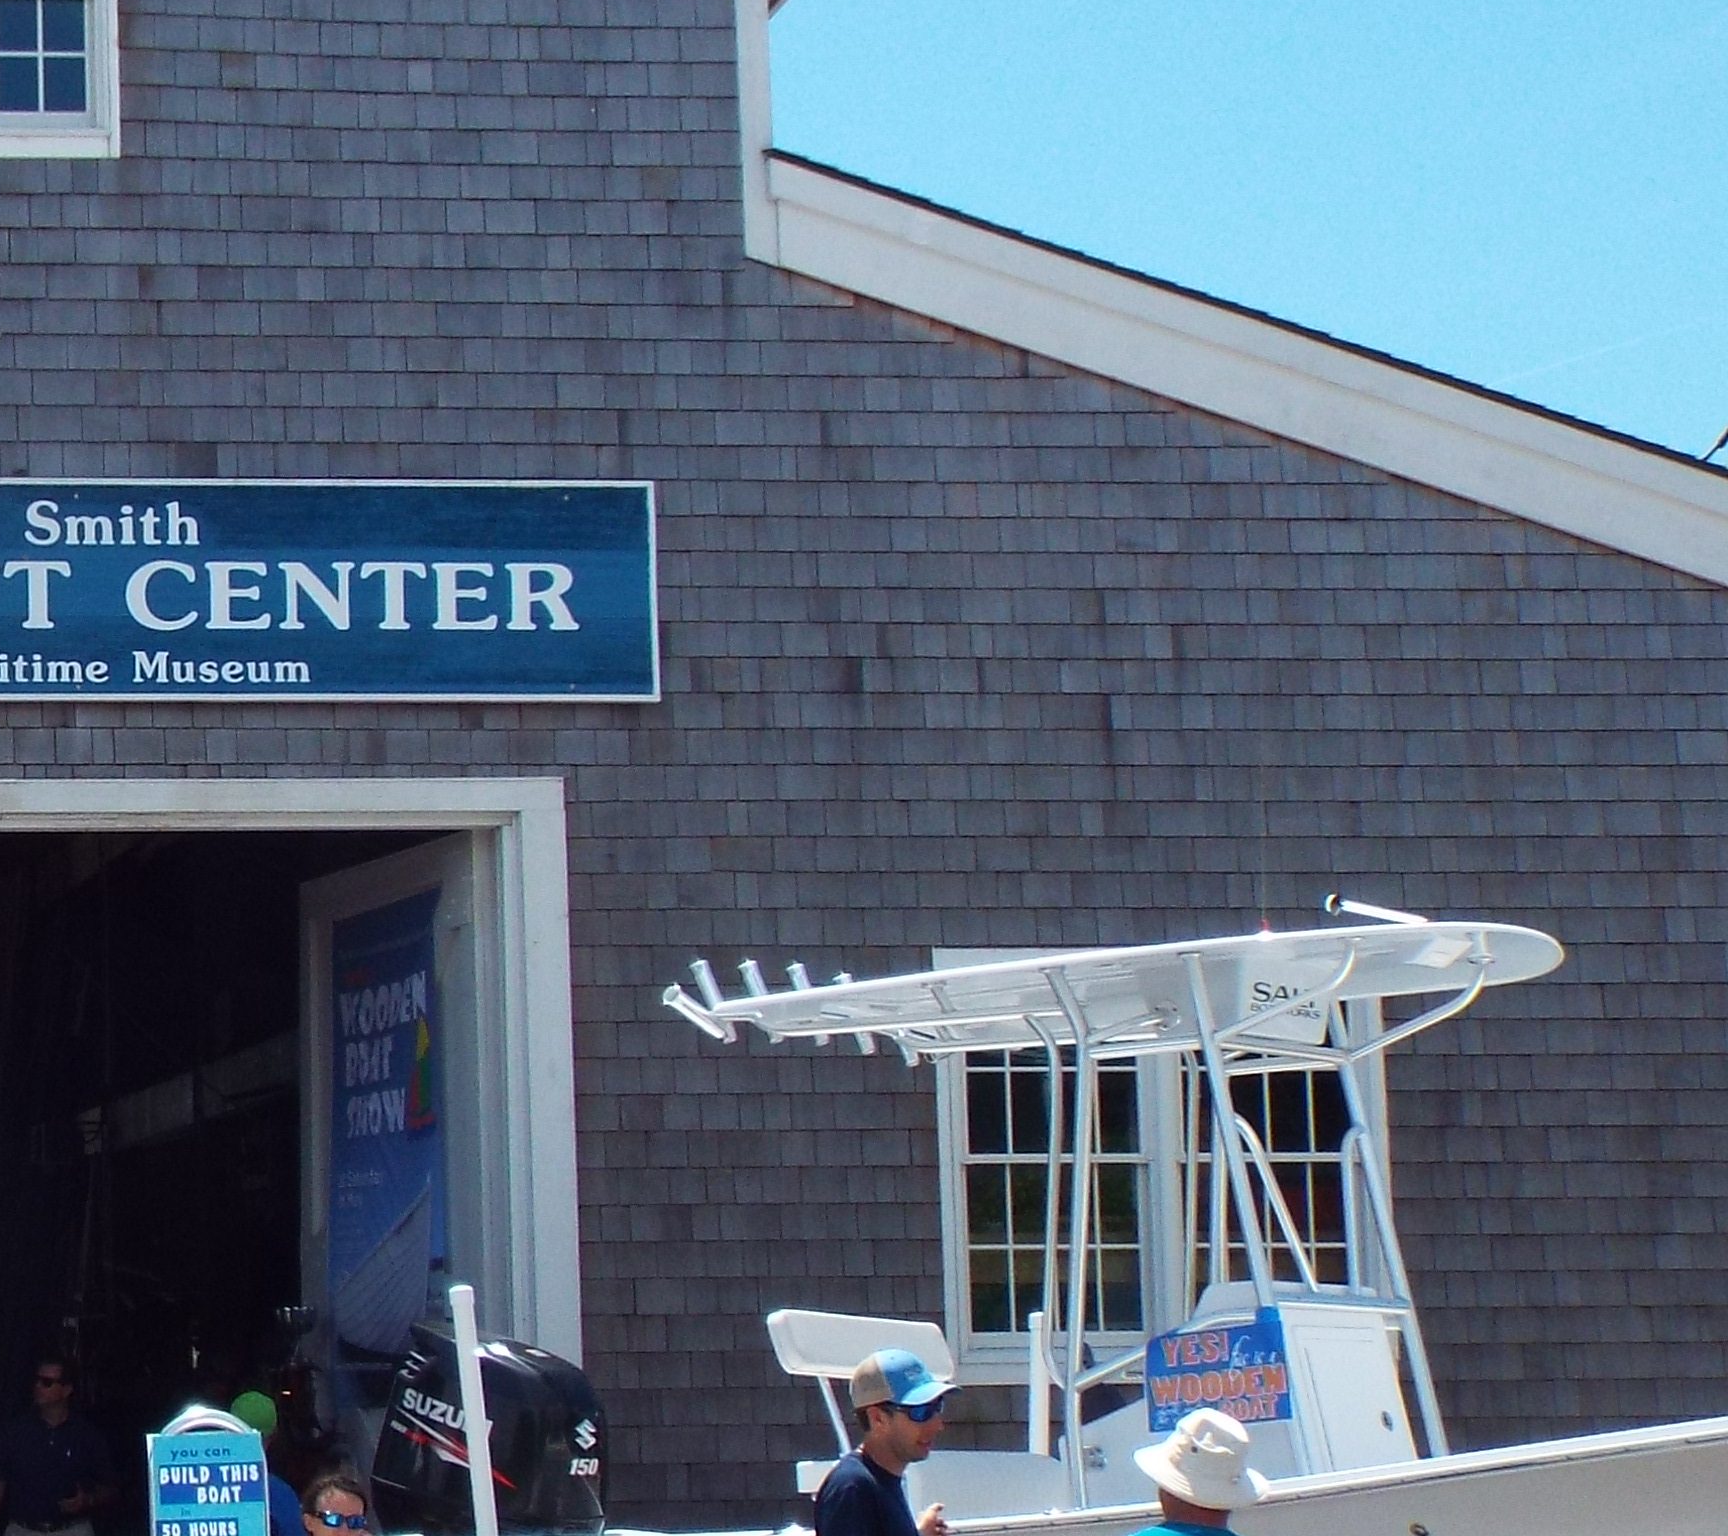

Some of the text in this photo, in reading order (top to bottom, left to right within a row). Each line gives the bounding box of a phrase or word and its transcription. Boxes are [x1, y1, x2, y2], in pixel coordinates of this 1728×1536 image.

[24, 499, 200, 546] Smith
[125, 560, 579, 631] CENTER
[132, 651, 311, 683] Museum
[340, 970, 426, 1037] WOODEN
[345, 1035, 393, 1087] BOAT
[347, 1087, 406, 1139] SHOW
[1160, 1331, 1229, 1367] YES!
[1151, 1364, 1287, 1406] WOODEN
[402, 1387, 493, 1433] SUZU
[159, 1464, 259, 1484] BUILD THIS
[171, 1448, 230, 1461] you can
[569, 1458, 599, 1475] 150
[197, 1486, 241, 1504] BOAT
